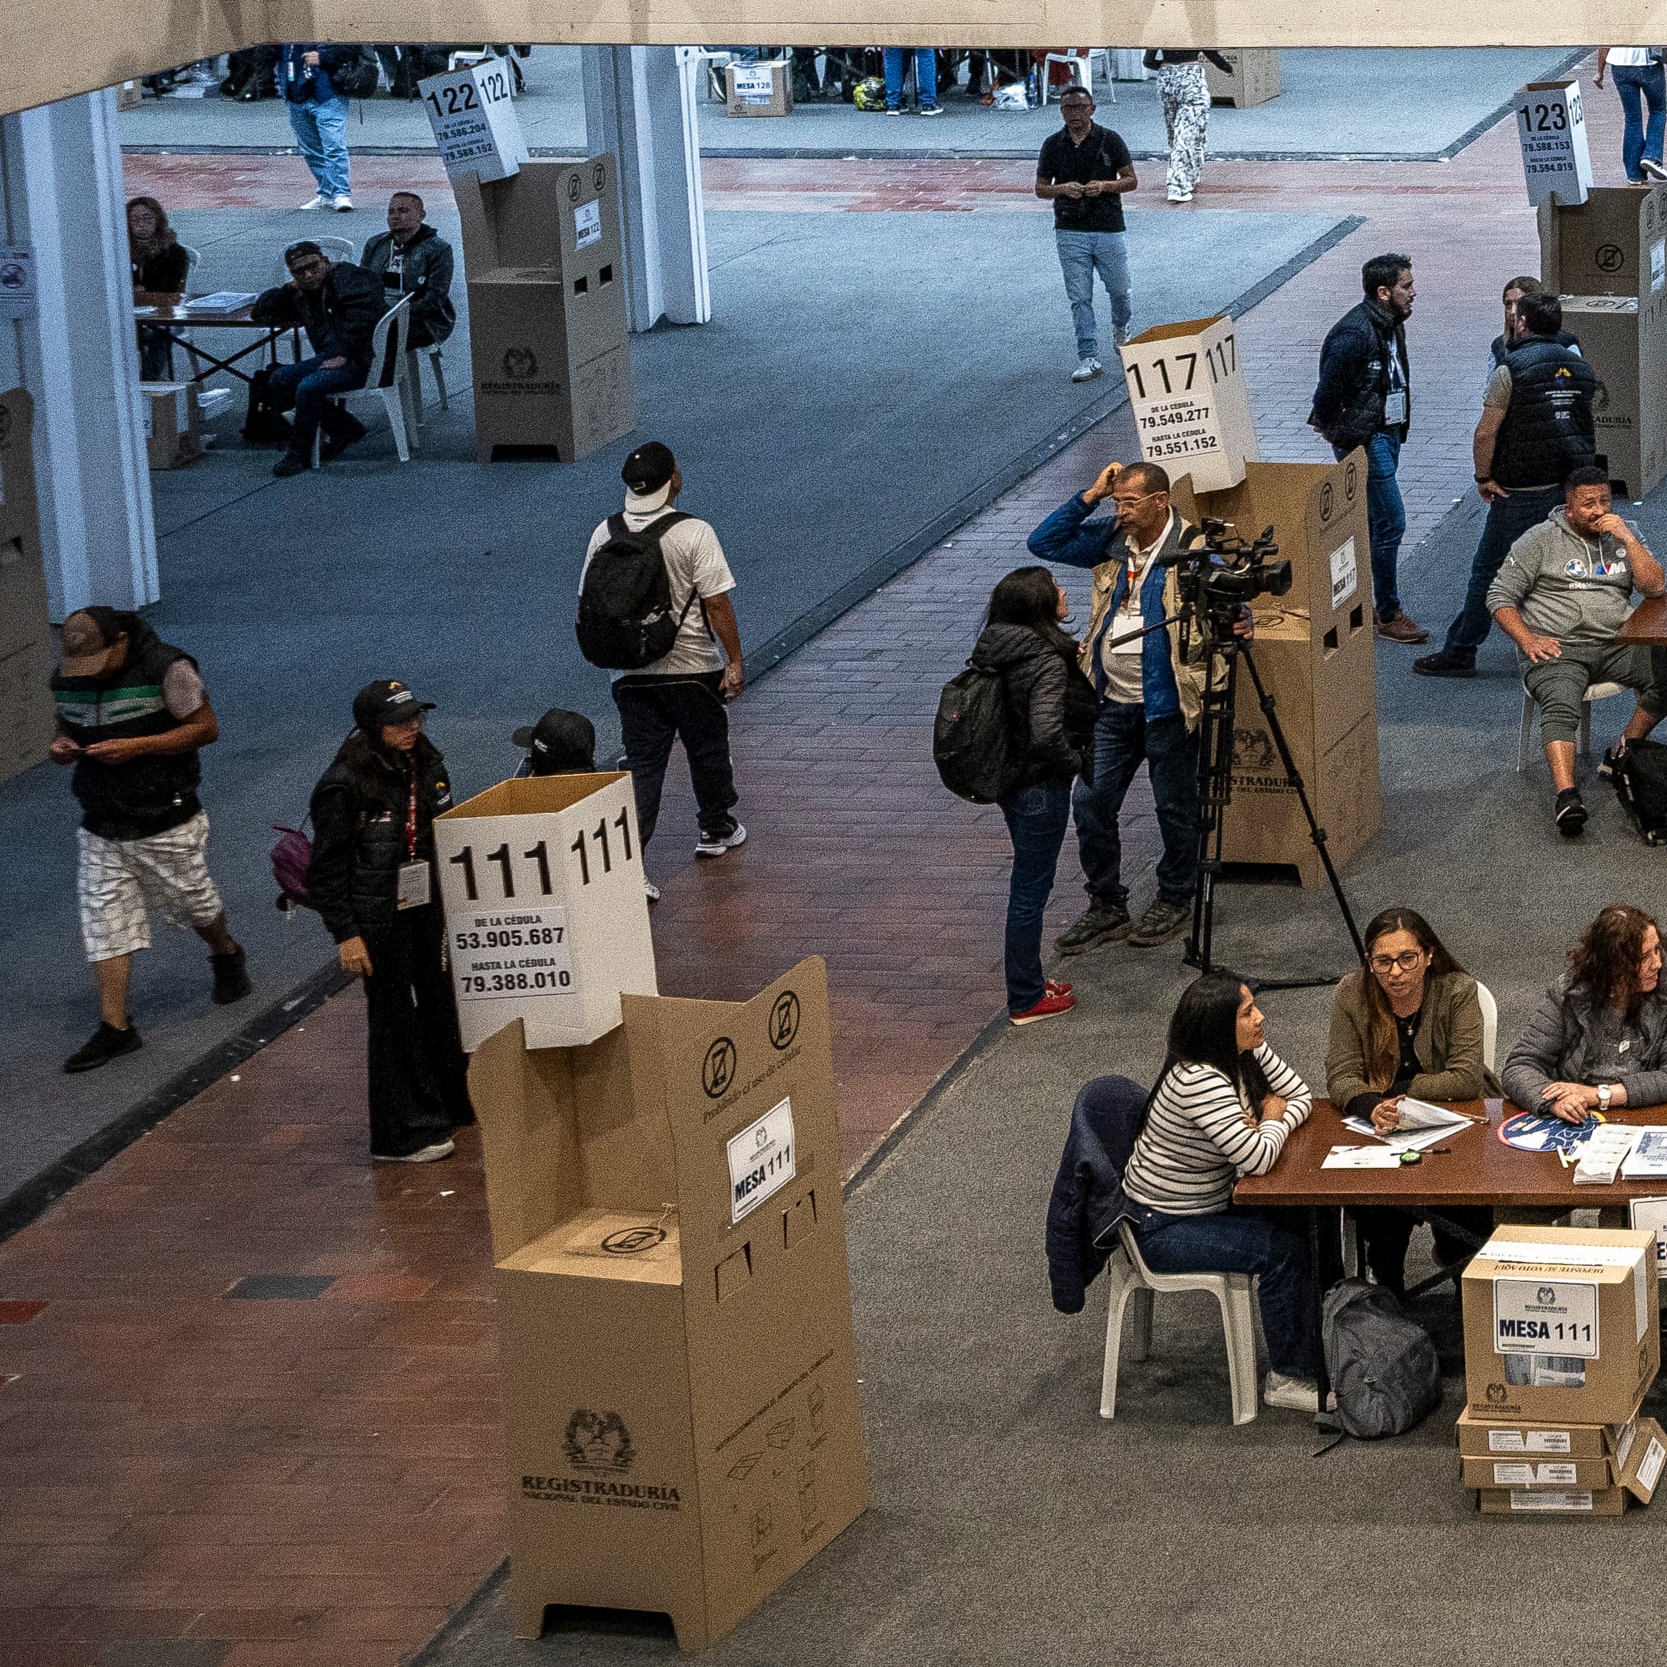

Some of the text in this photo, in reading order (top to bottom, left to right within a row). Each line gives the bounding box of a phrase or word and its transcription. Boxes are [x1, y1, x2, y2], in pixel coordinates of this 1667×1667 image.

[427, 82, 480, 119] 122
[480, 72, 509, 105] 122
[1519, 102, 1567, 133] 123
[1569, 94, 1583, 127] 123
[1204, 333, 1237, 384] 117
[1125, 352, 1198, 399] 117
[1140, 407, 1210, 430] 79.549.277
[1145, 436, 1217, 459] 79.551.152
[571, 805, 635, 887] 111
[449, 840, 556, 902] 111
[475, 912, 543, 928] DE LA CÉDULA
[456, 927, 566, 951] 53.905.687
[471, 956, 558, 973] HASTA LA CÉDULA
[461, 970, 572, 995] 79.388.010
[734, 1144, 791, 1204] MESA 111
[1498, 1318, 1591, 1342] MESA 111
[521, 1475, 682, 1503] REGISTRADURÍA
